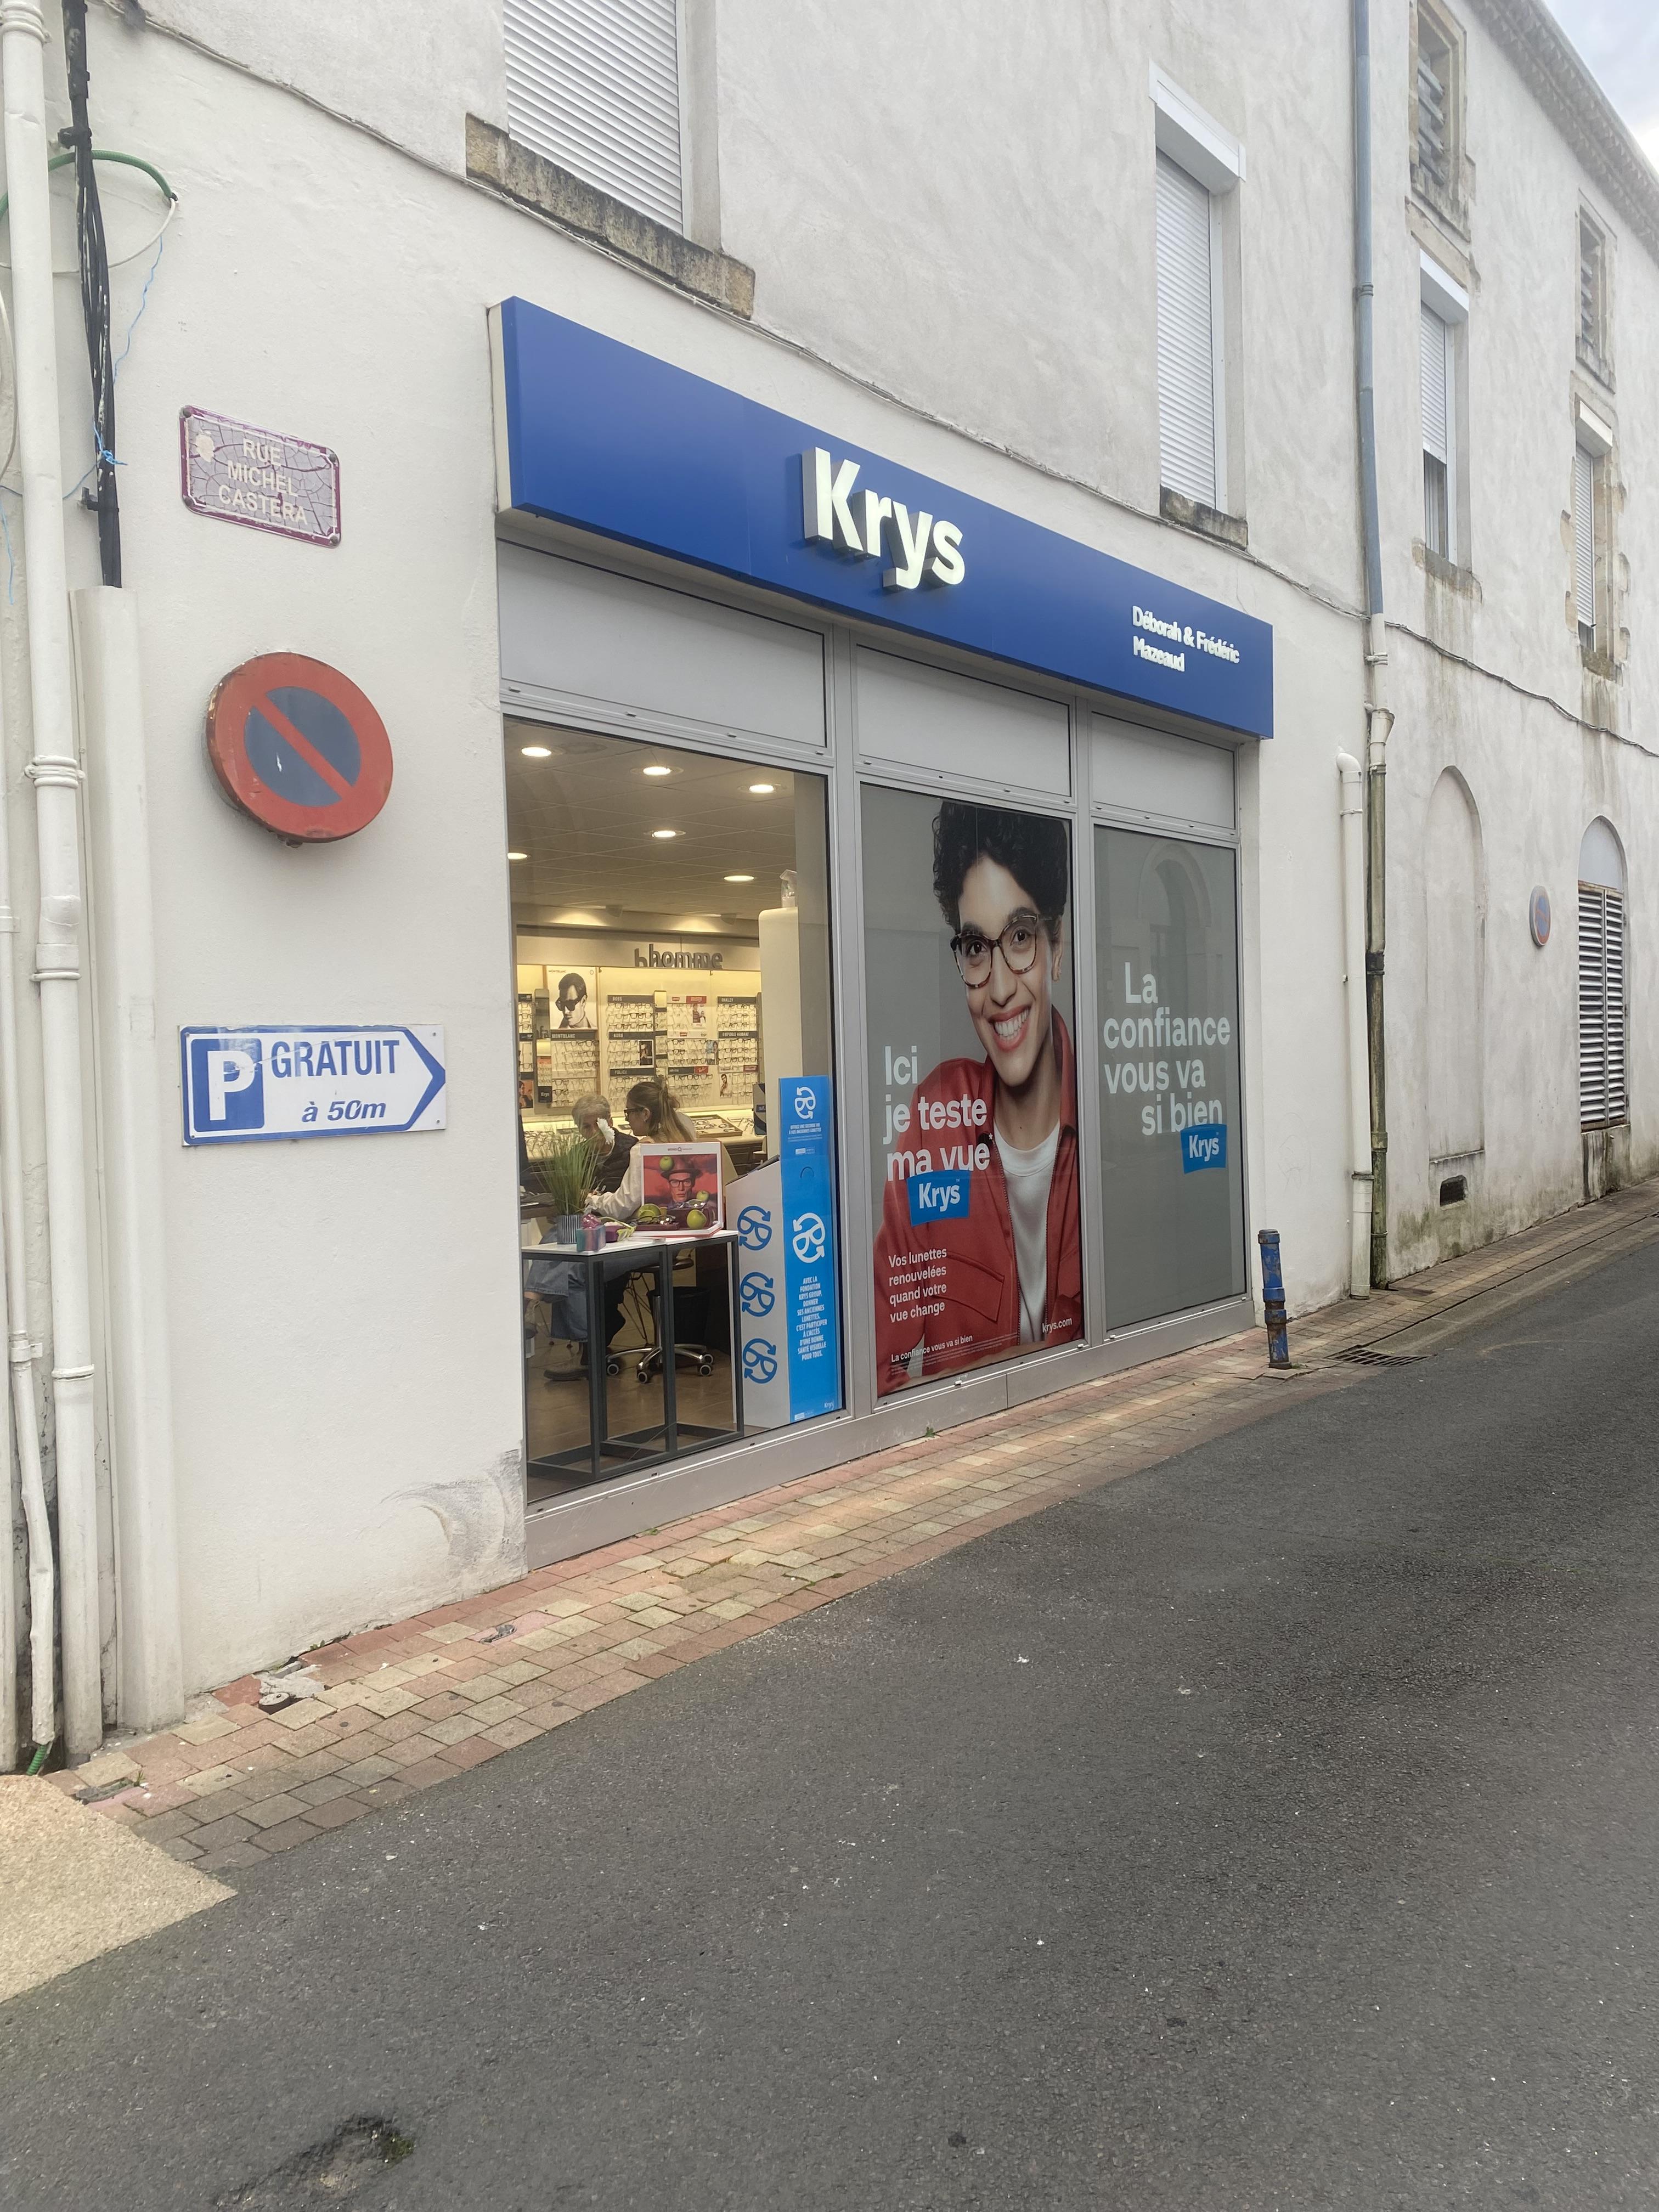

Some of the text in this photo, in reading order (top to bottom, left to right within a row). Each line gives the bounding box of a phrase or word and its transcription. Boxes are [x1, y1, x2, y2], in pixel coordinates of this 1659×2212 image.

[242, 438, 281, 467] RUE
[227, 460, 298, 497] MICHEL
[219, 484, 308, 525] CASTERA
[802, 447, 966, 591] Krys
[1132, 605, 1240, 664] Déborah & Frédéric
[649, 943, 723, 970] homme
[1125, 962, 1159, 1004] La
[1103, 1007, 1231, 1049] confiance
[207, 1040, 399, 1121] P GRATUIT
[885, 1046, 918, 1085] Ici
[1104, 1059, 1206, 1094] vous va
[301, 1100, 386, 1122] à 50m
[883, 1094, 987, 1145] je teste
[1142, 1092, 1223, 1136] si bien
[1189, 1135, 1220, 1162] Krys
[887, 1149, 933, 1181] ma
[918, 1182, 961, 1212] Krys
[888, 1248, 947, 1268] Vos lunettes
[889, 1265, 946, 1286] renouvelées
[889, 1283, 947, 1307] quand votre
[890, 1302, 945, 1323] vue change
[1042, 1318, 1073, 1333] krys.com
[891, 1354, 899, 1362] La
[900, 1346, 930, 1359] confiance
[931, 1343, 945, 1352] vous
[955, 1336, 960, 1346] si
[961, 1334, 973, 1344] bien
